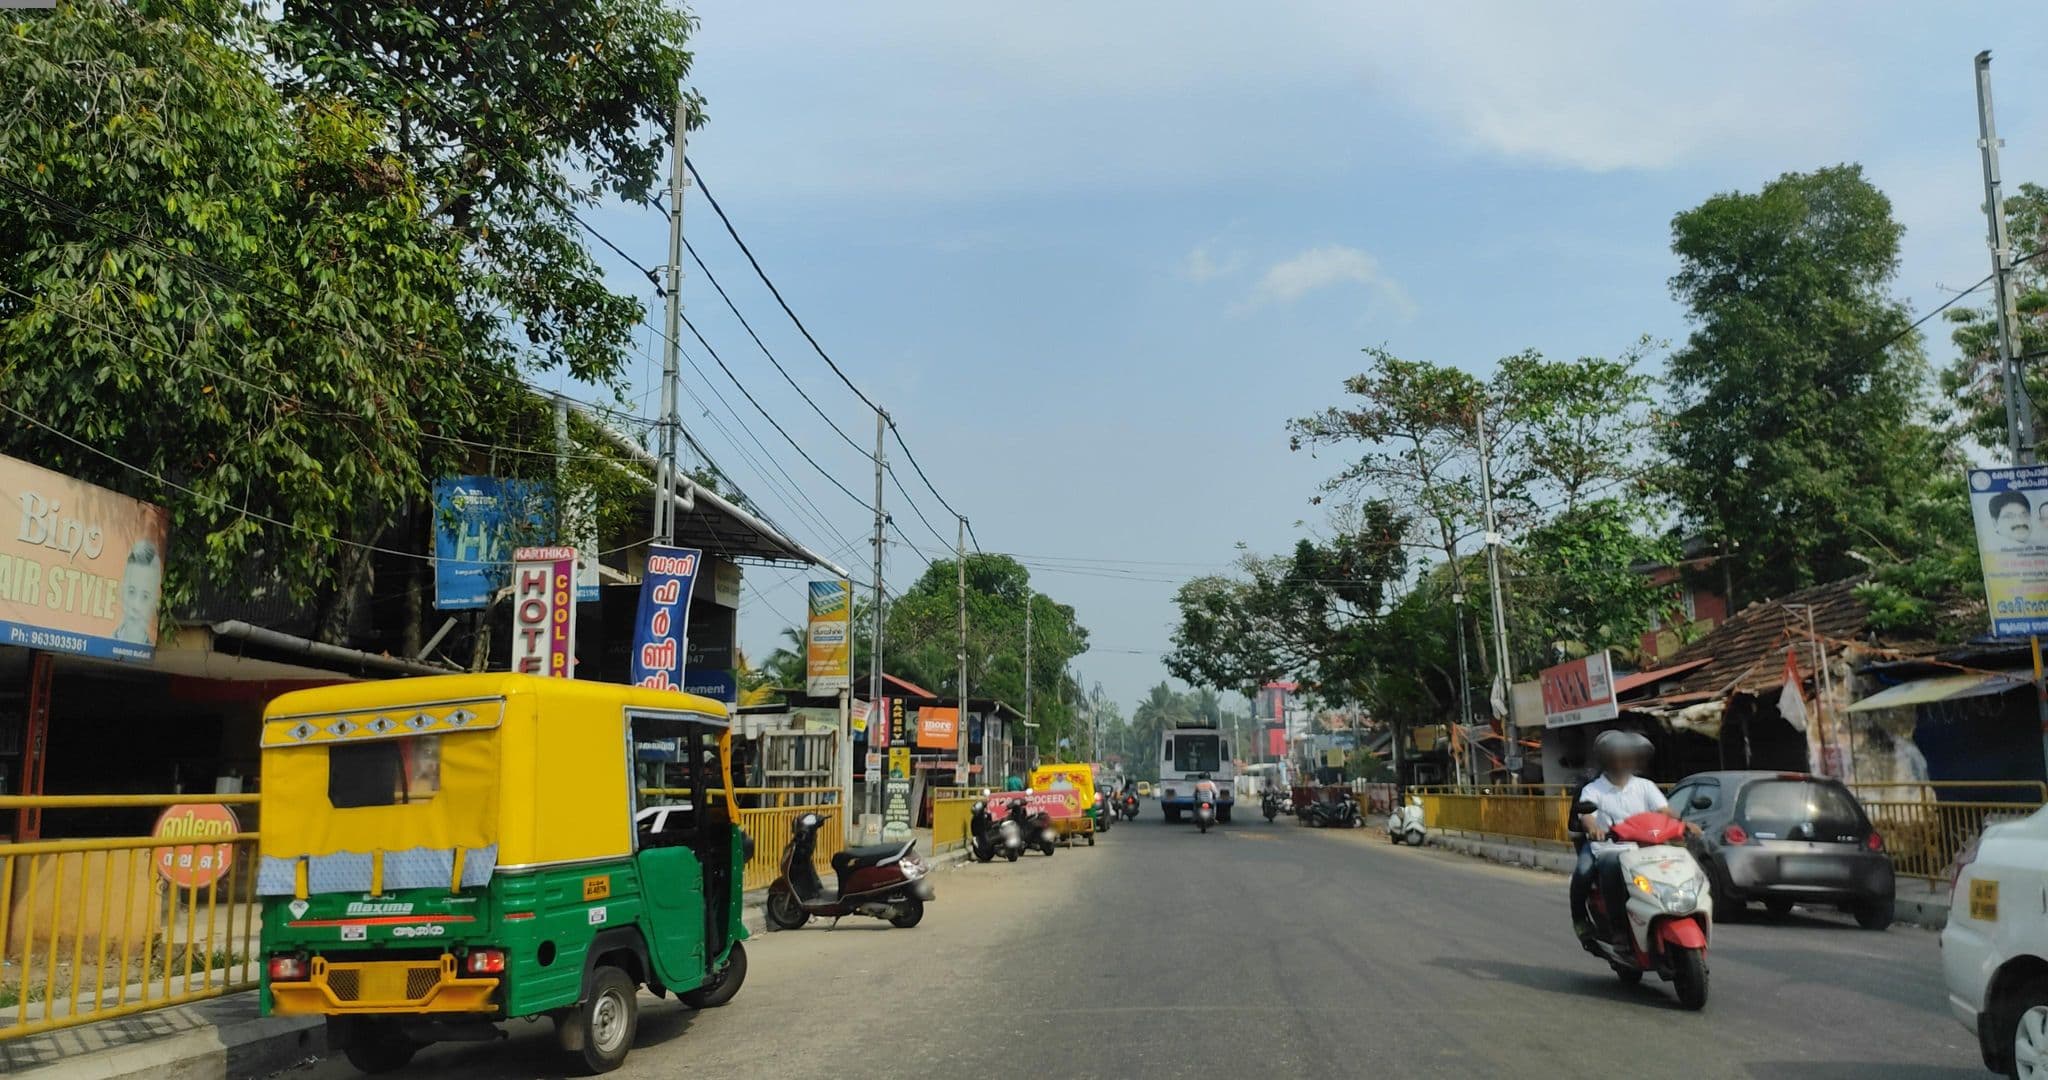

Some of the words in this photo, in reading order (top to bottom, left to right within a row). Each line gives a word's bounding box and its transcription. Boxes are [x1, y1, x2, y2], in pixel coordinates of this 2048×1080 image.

[17, 491, 104, 563] Bino
[516, 549, 570, 560] KARTHIKA
[647, 554, 695, 576] ഡാനി
[46, 565, 118, 620] STYLE
[554, 575, 568, 640] COOL
[11, 627, 28, 643] Ph:
[925, 720, 951, 731] more
[346, 902, 414, 914] Maxima
